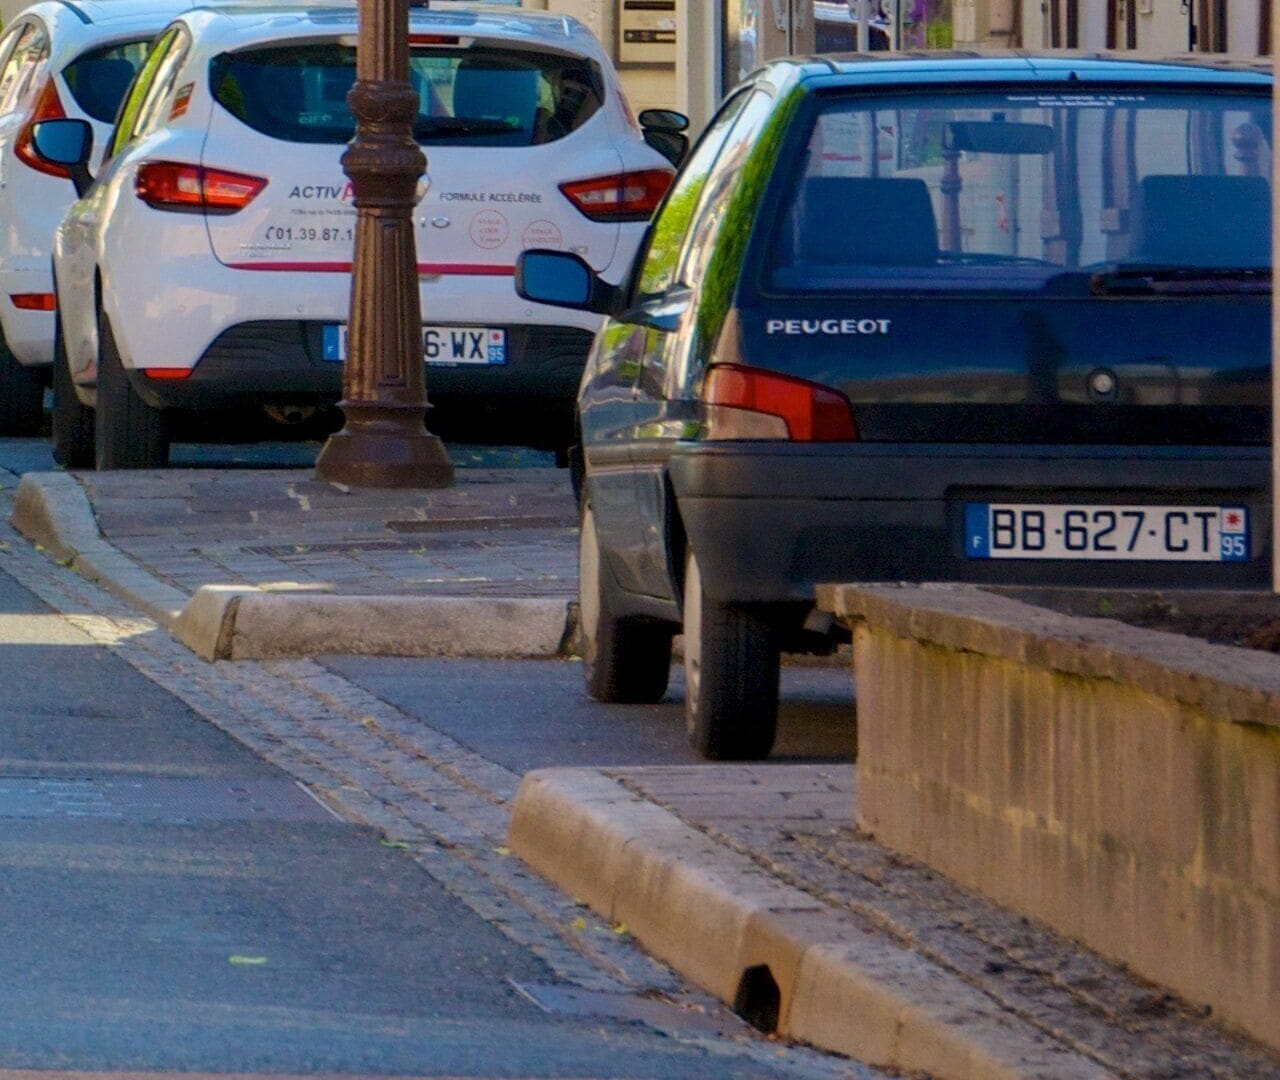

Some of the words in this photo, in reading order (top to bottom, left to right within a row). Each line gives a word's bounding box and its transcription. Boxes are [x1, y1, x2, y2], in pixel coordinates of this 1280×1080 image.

[439, 192, 486, 202] FORMULE
[766, 319, 891, 334] PEUGEOT
[489, 347, 503, 361] 95
[973, 536, 982, 549] F
[992, 509, 1217, 552] BB-627-CT
[1222, 536, 1245, 556] 95
